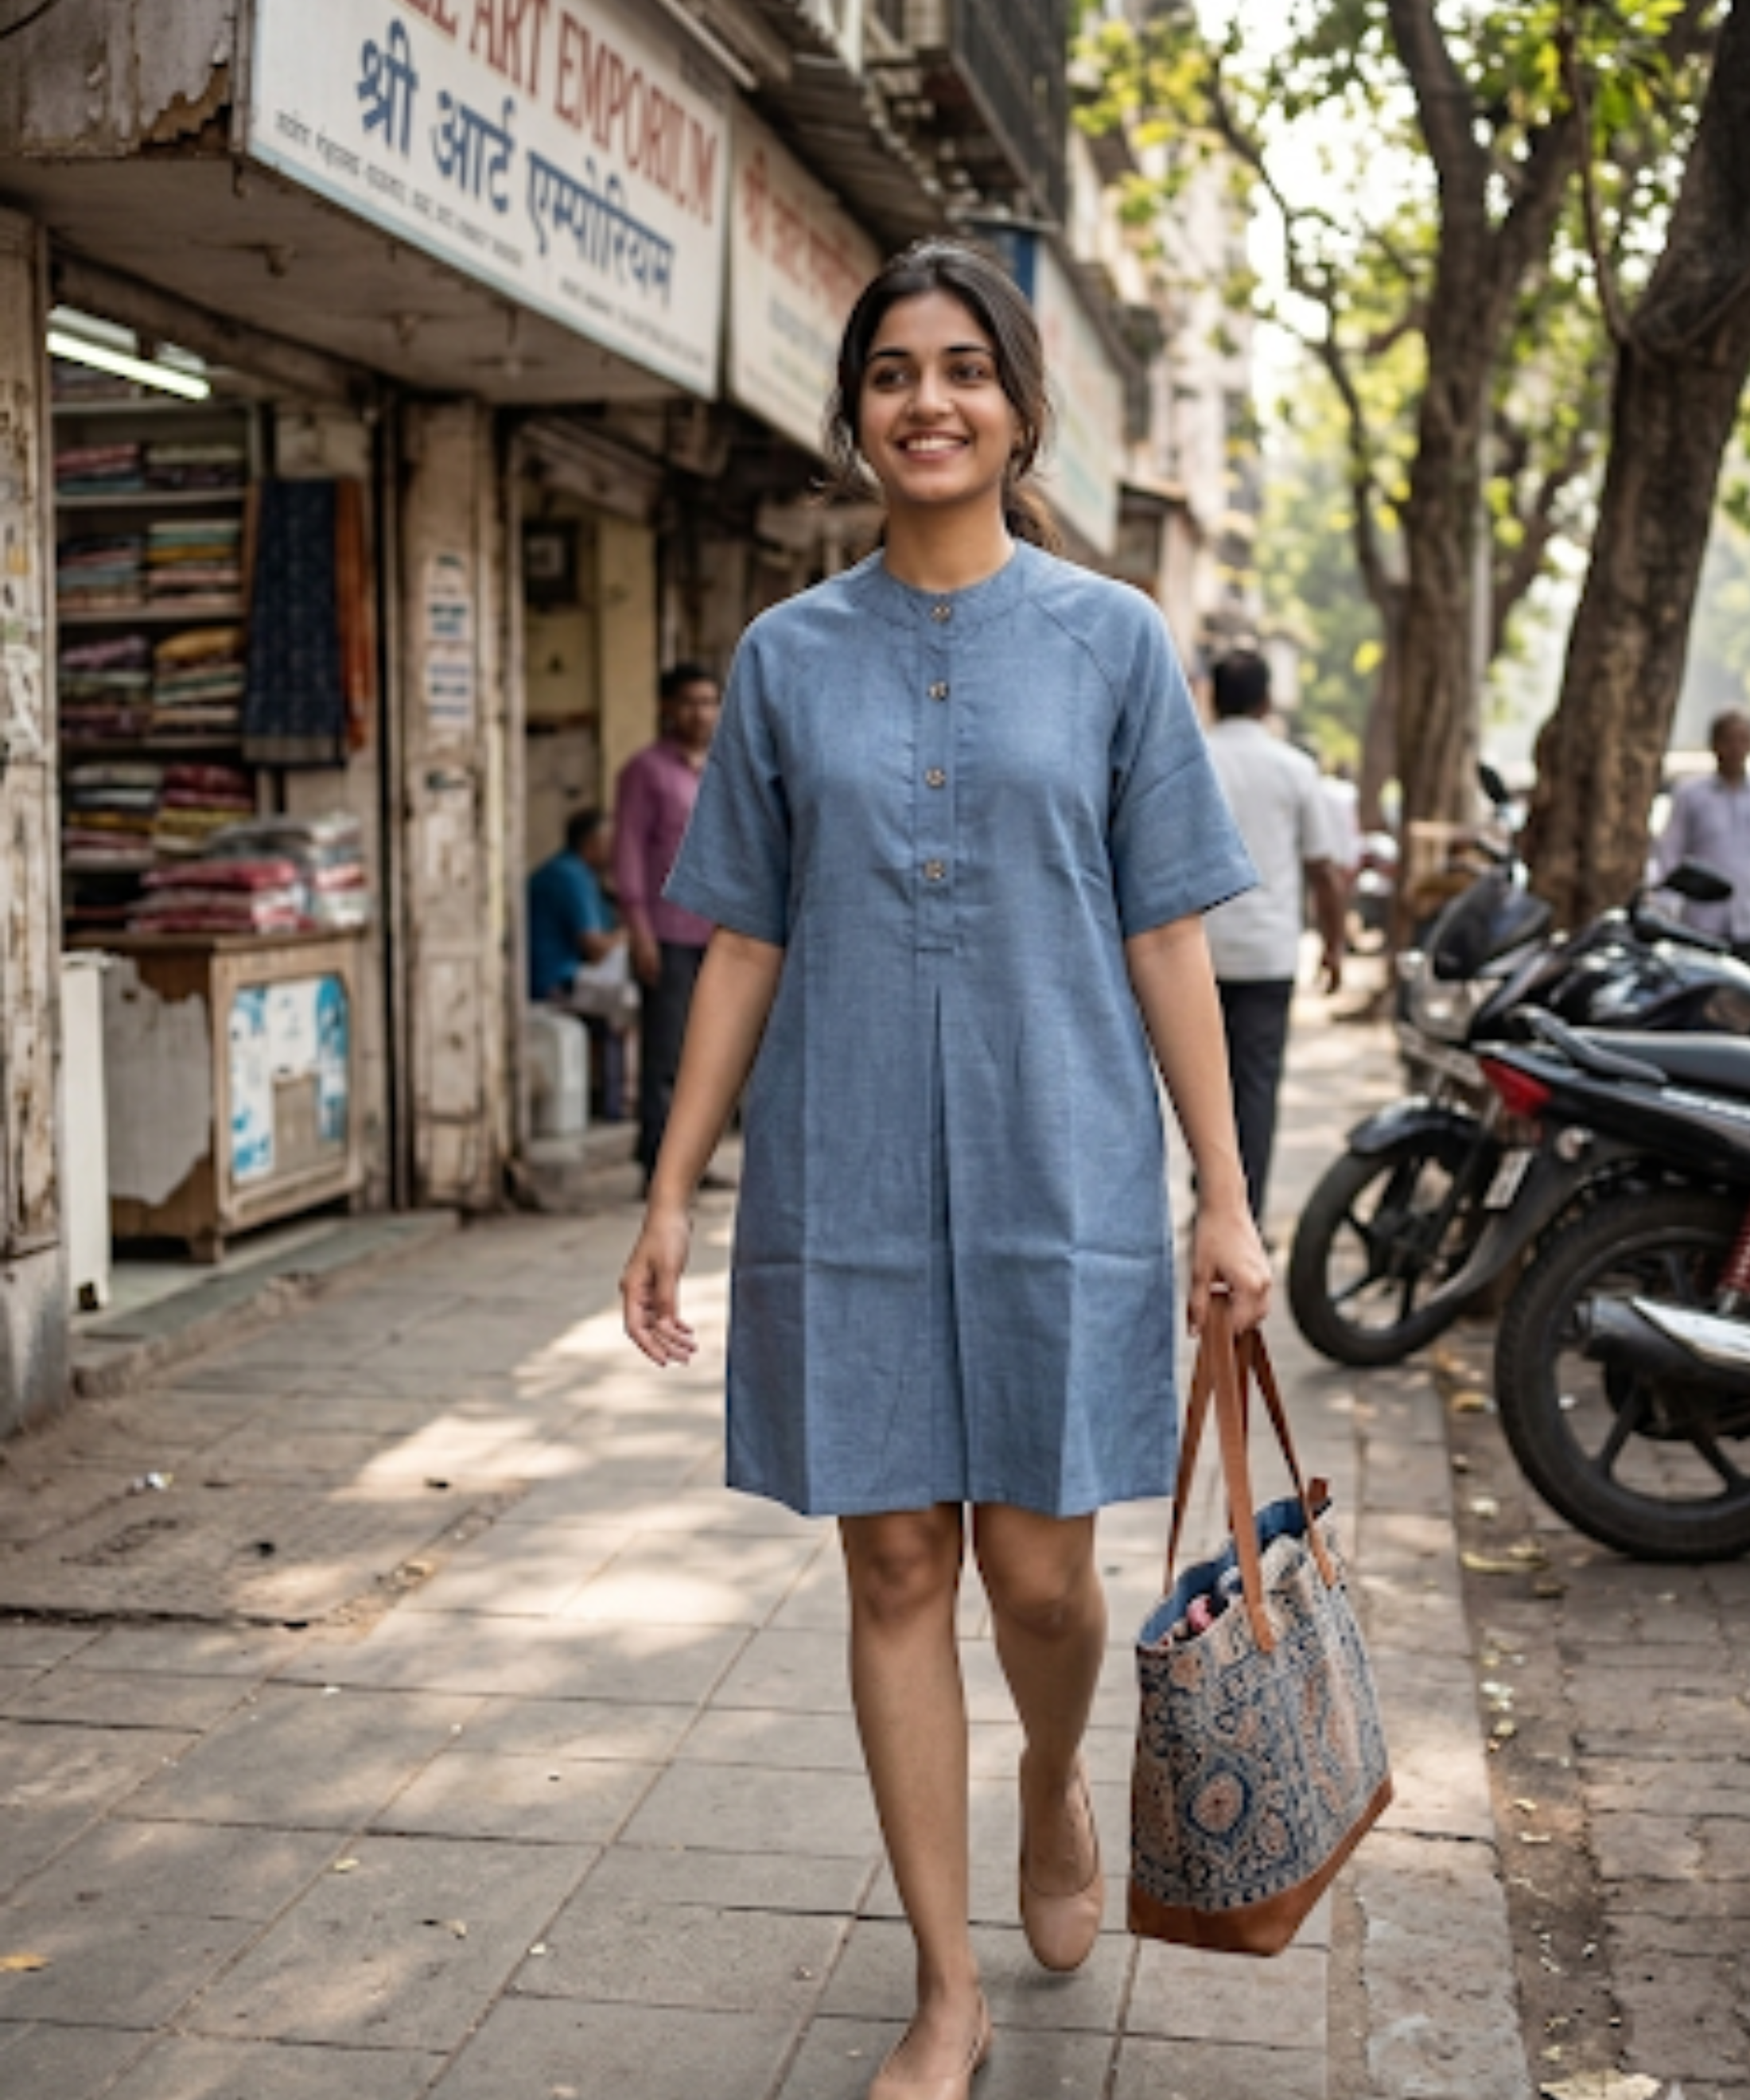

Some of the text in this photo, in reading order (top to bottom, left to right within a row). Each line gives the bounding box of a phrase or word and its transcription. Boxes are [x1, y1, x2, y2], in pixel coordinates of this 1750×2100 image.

[356, 20, 418, 158] श्री
[430, 91, 515, 213] आर्ट
[469, 0, 550, 98] ART
[554, 10, 718, 228] EMPORIUM
